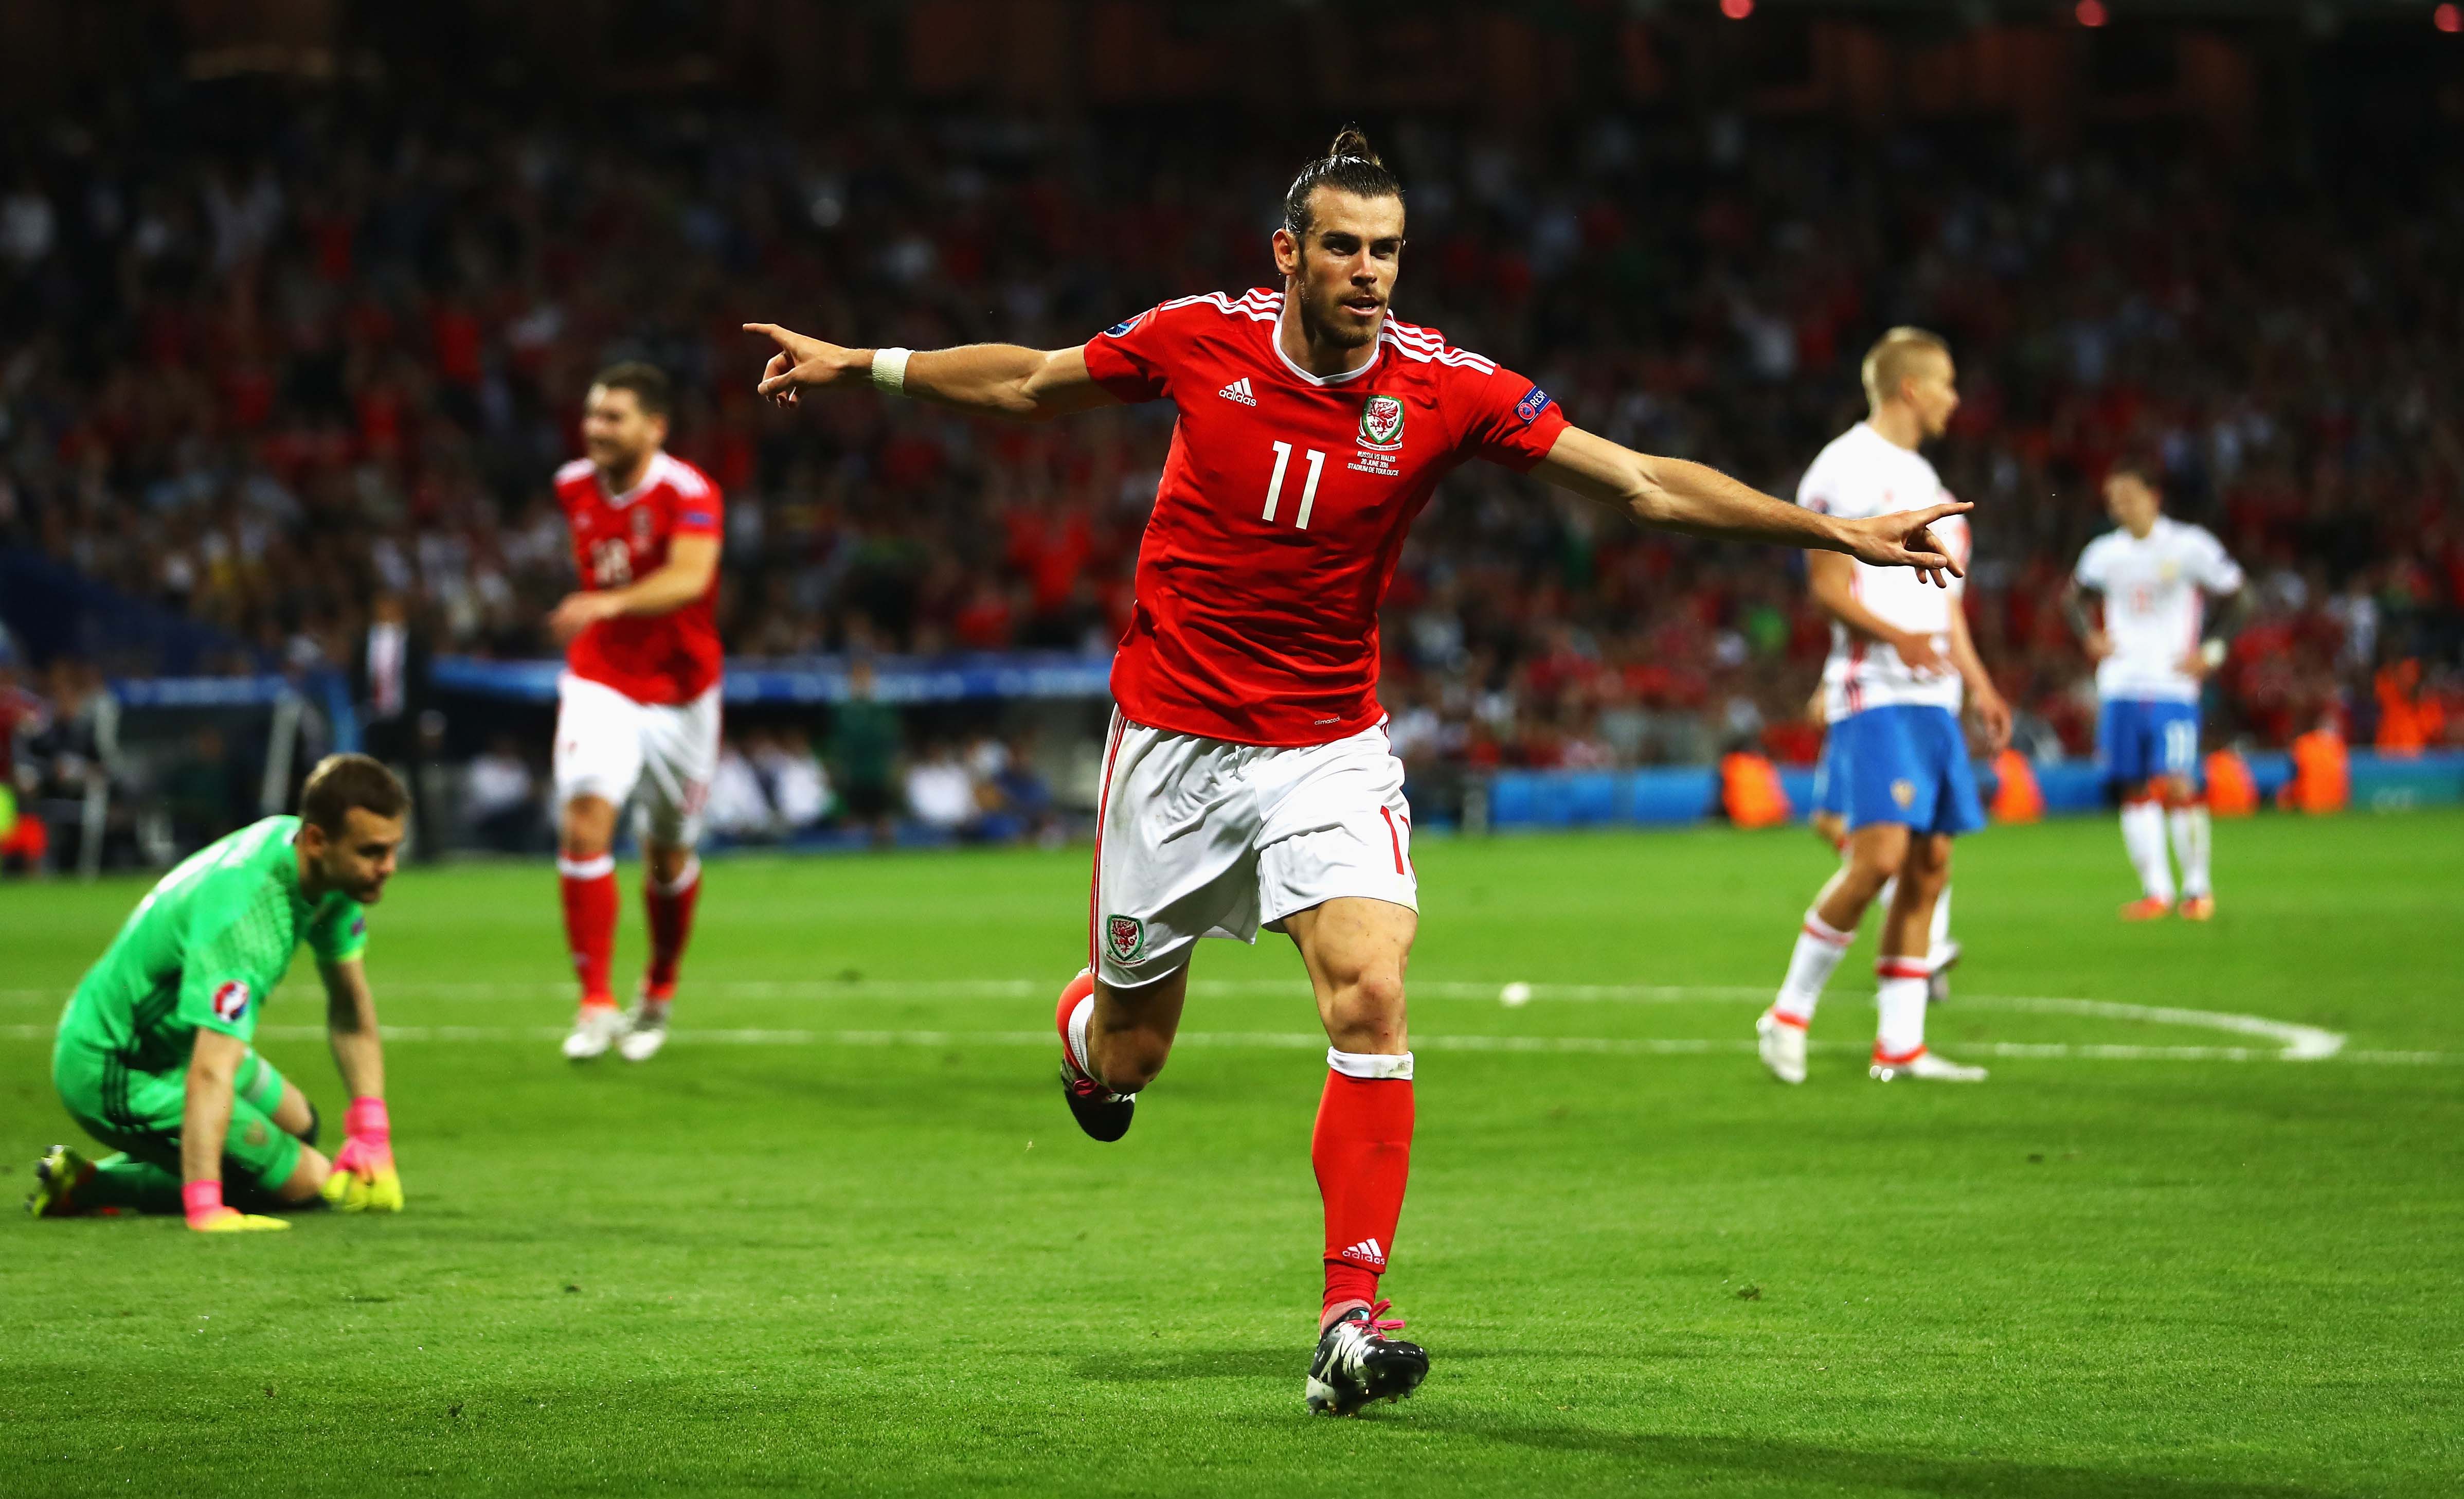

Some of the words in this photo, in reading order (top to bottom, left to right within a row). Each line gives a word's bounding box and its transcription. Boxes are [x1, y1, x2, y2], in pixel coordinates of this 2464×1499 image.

[1219, 389, 1257, 406] adidas
[1530, 389, 1547, 408] RESP
[1347, 463, 1368, 472] STADIUM
[1262, 440, 1326, 530] 11
[1314, 716, 1340, 725] climacool
[1342, 1251, 1385, 1265] adidas
